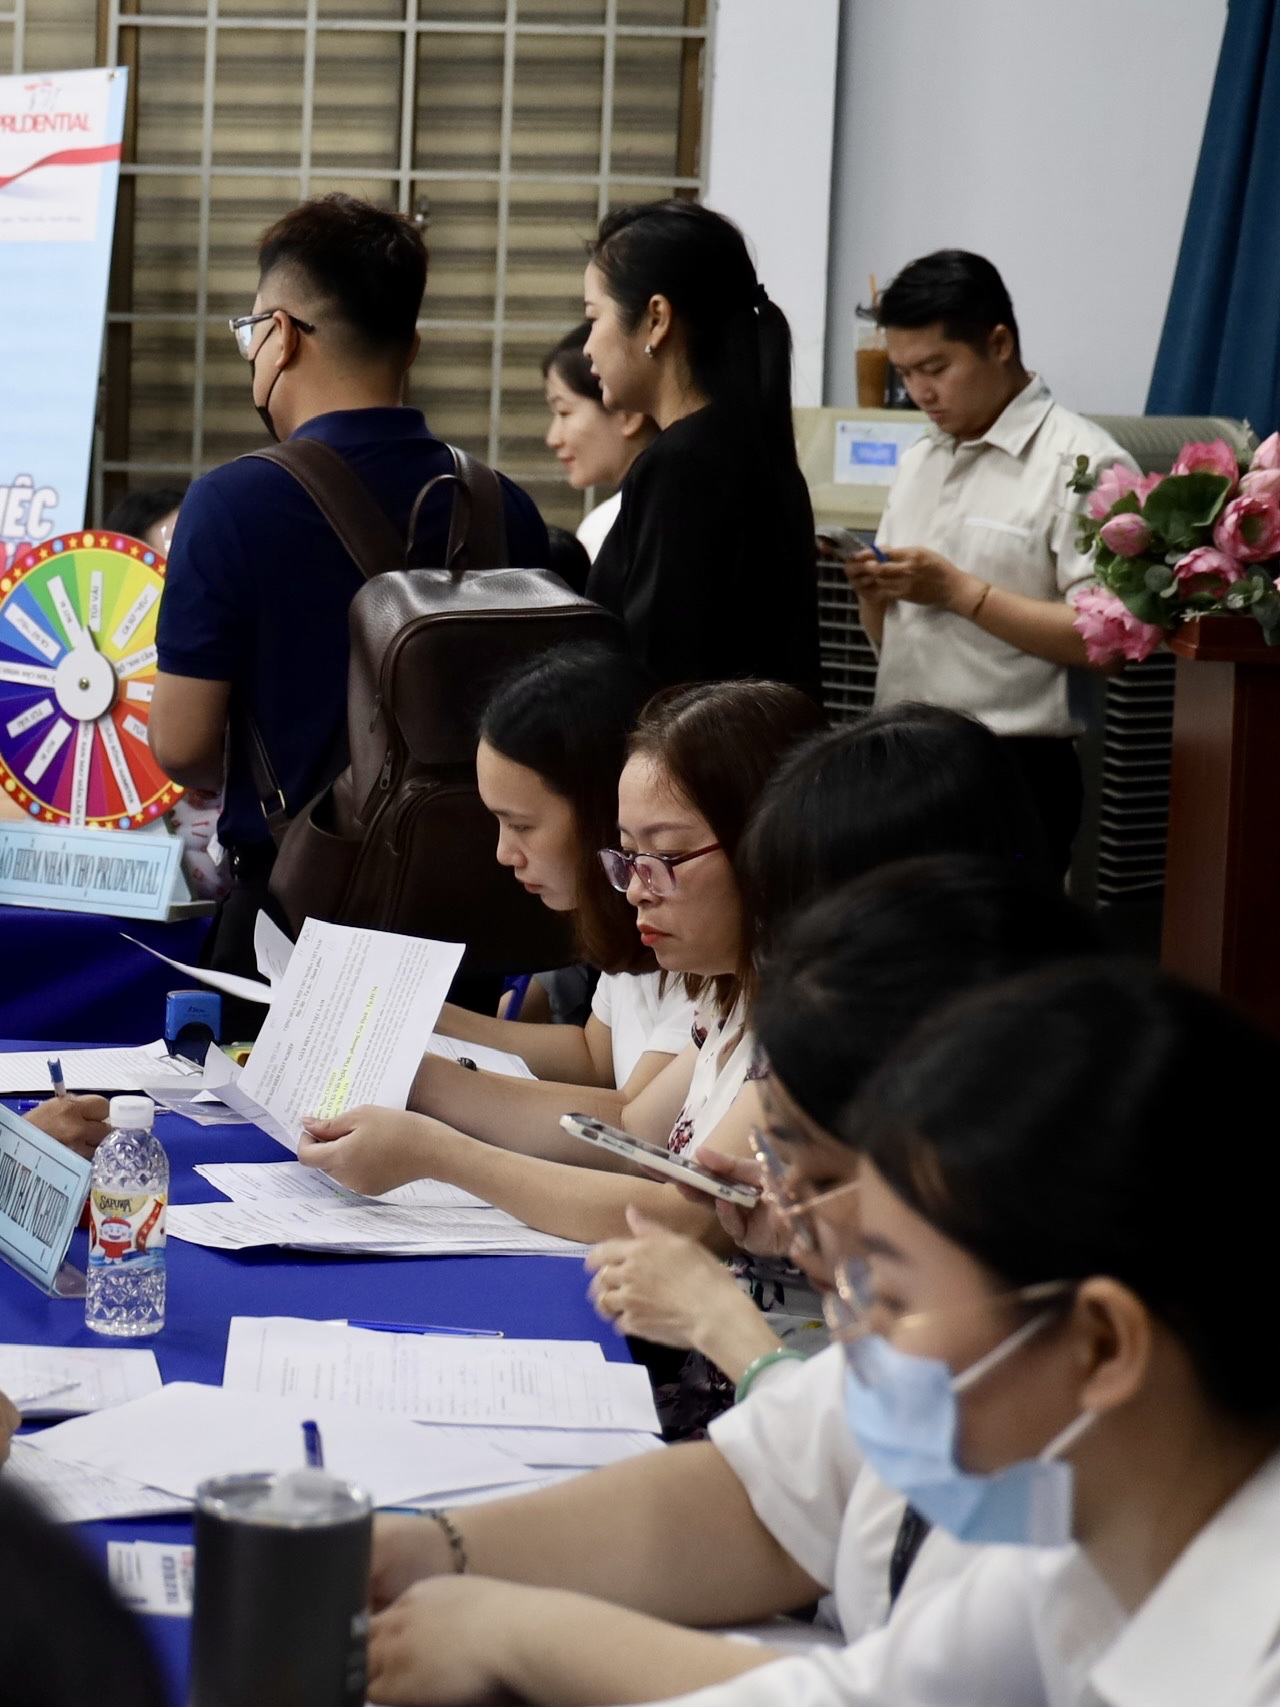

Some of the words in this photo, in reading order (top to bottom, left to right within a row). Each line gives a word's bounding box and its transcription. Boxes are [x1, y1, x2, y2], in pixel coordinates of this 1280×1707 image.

[89, 603, 98, 619] TÚI
[38, 841, 75, 886] NHÂN
[68, 853, 98, 897] THỌ
[92, 855, 163, 895] PRUDENTIAL
[6, 1154, 42, 1230] THẤT
[25, 1177, 71, 1262] NGHIỆP
[100, 1195, 132, 1213] SAPUWA
